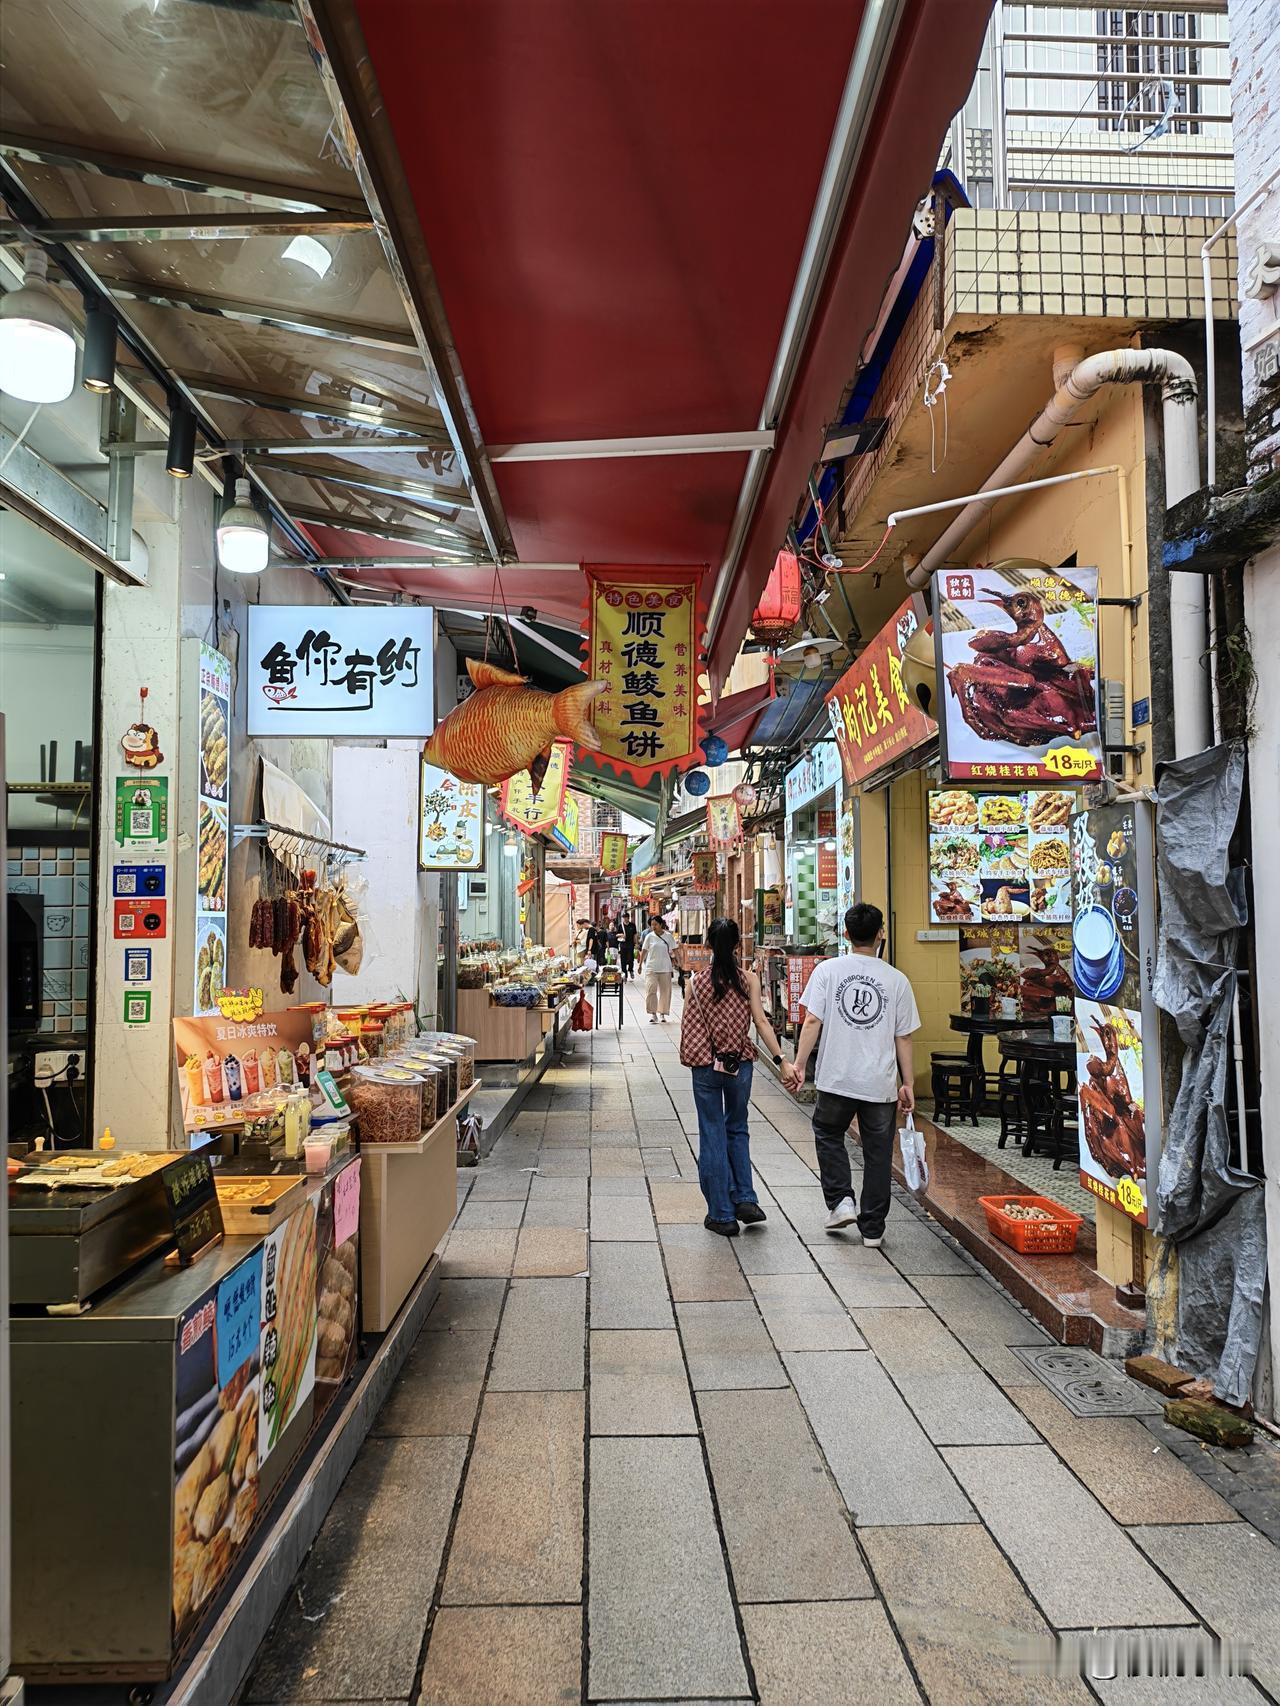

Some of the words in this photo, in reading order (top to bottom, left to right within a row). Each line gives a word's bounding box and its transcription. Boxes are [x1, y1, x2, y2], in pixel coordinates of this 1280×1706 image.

[949, 577, 971, 588] 独家
[606, 590, 683, 608] 特色美食
[260, 629, 421, 711] 鱼你有约
[673, 643, 688, 718] 营养美味
[620, 611, 666, 759] 顺德鲮鱼饼
[440, 768, 457, 791] 会
[971, 764, 1039, 777] 红烧桂花鸽
[458, 781, 479, 819] 陈皮
[1073, 811, 1102, 914] 双皮奶
[835, 974, 876, 1001] UNDERBROKEN
[216, 1023, 278, 1041] 夏日冰爽特饮
